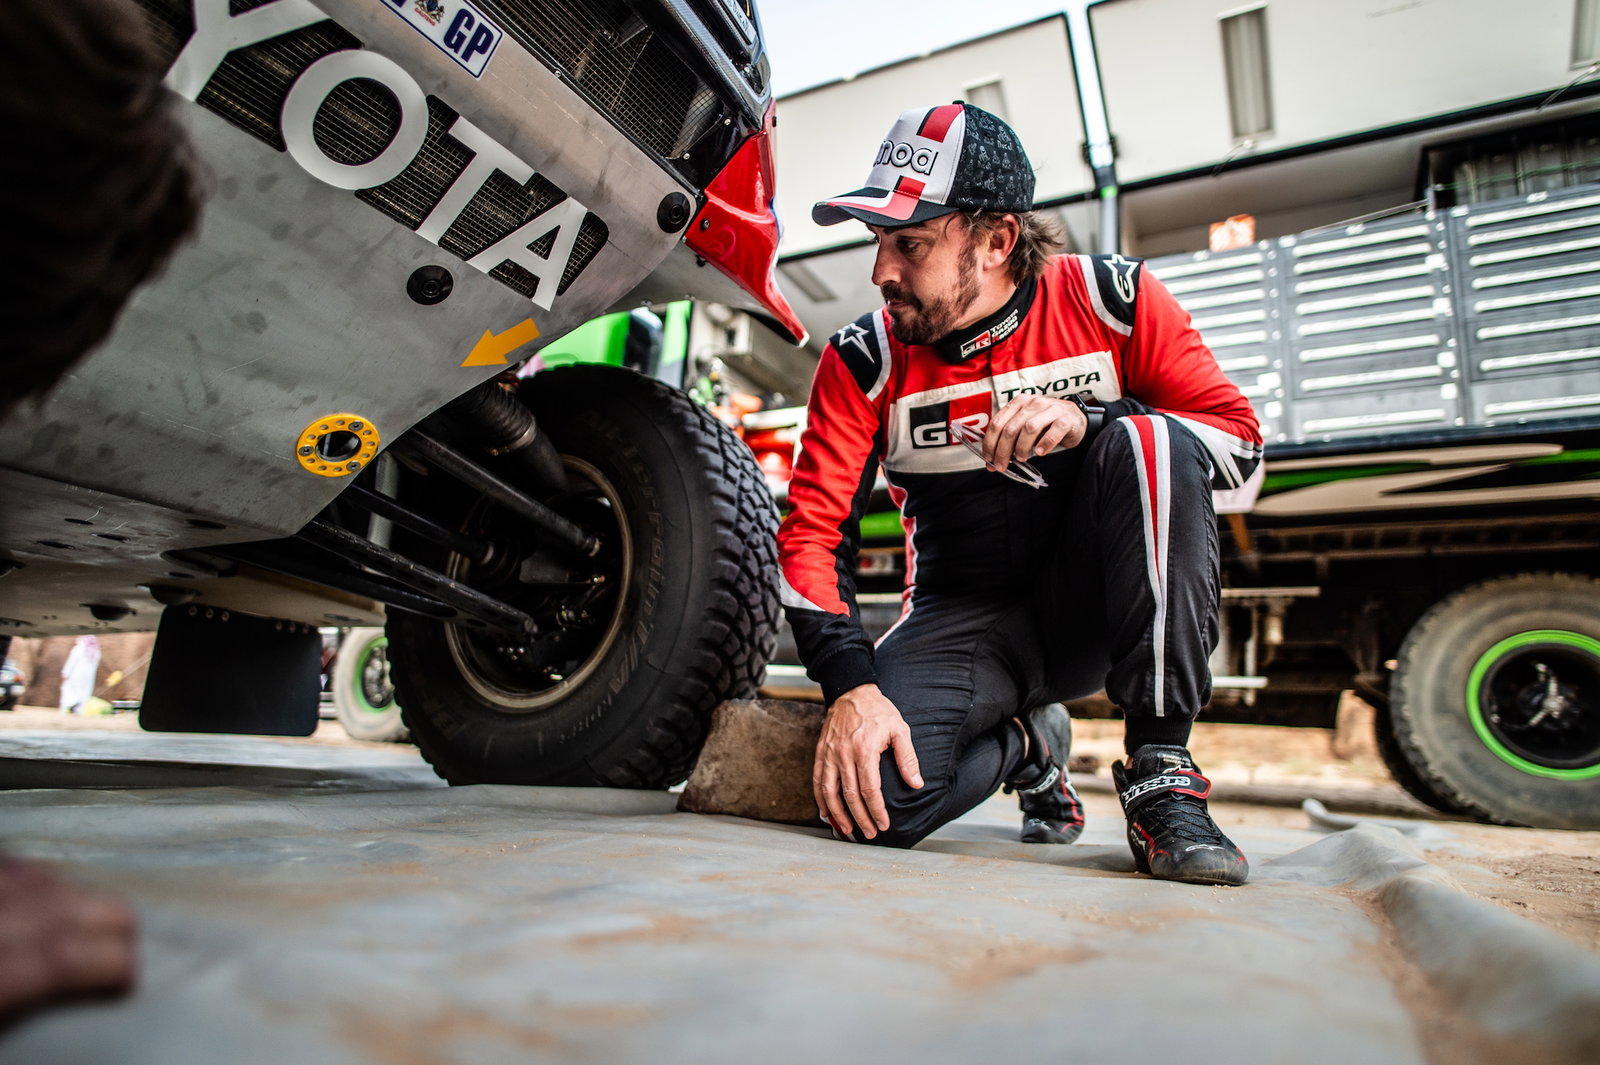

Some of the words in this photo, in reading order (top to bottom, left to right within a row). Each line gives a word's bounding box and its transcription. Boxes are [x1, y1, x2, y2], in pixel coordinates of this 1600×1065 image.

[443, 8, 494, 63] GP
[990, 308, 1019, 333] TOYOTA
[963, 337, 991, 357] GR
[1001, 370, 1101, 402] TOYOTA
[913, 411, 990, 447] GR
